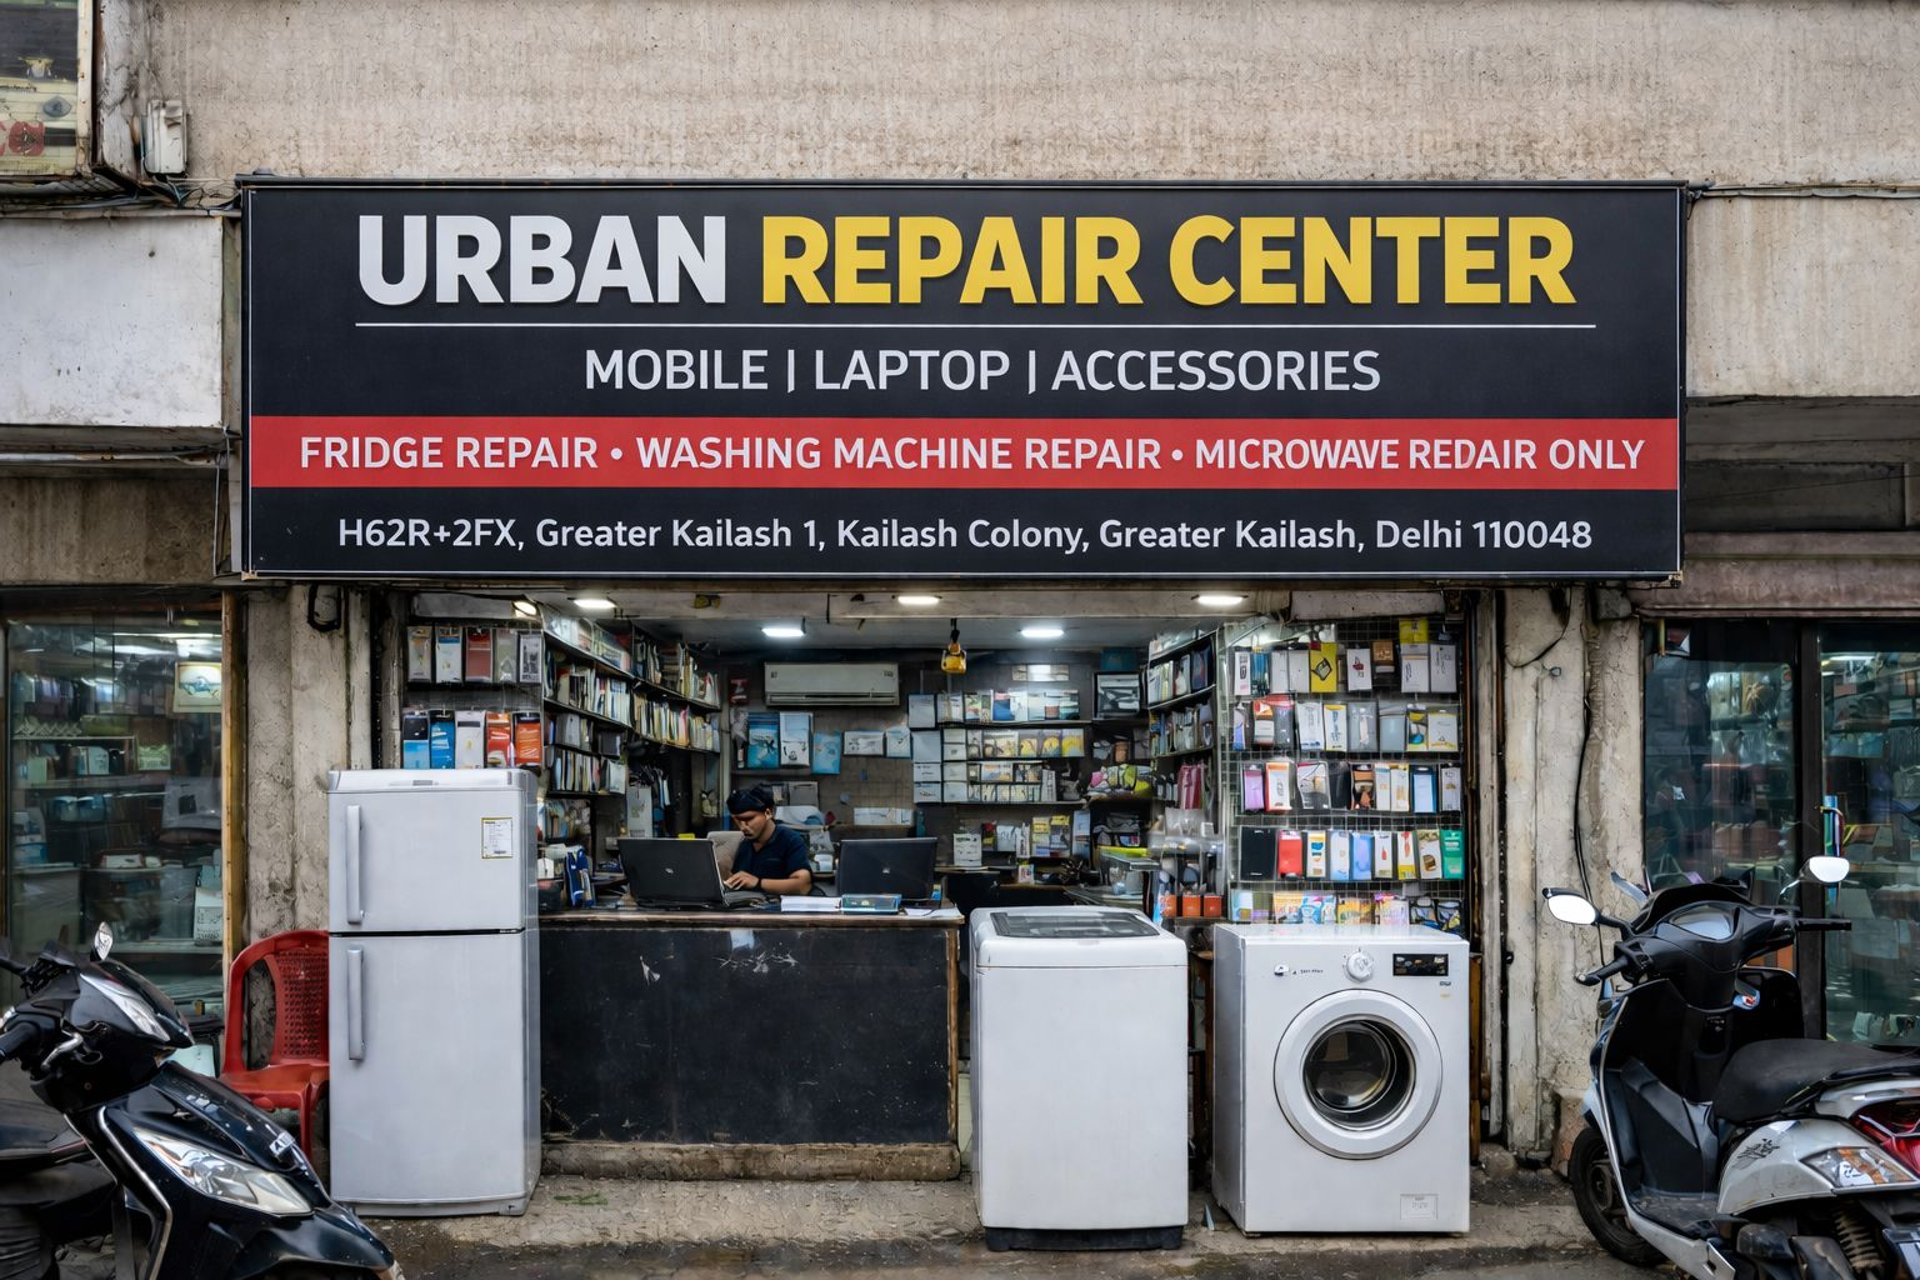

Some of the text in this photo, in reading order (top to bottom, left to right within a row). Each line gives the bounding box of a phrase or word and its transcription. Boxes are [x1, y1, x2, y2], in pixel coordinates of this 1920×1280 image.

[359, 214, 1577, 306] URBAN REPAIR CENTER
[585, 349, 769, 390] MOBILE
[815, 350, 1010, 391] LAPTOP
[1051, 350, 1381, 391] ACCESSORIES
[300, 436, 444, 469] FRIDGE
[456, 436, 599, 469] REPAIR
[635, 436, 821, 470] WASHING
[834, 438, 1013, 470] MACHINE
[1025, 438, 1162, 470] REPAIR
[1195, 438, 1400, 470] MICROWAVE
[1549, 438, 1645, 470] ONLY
[338, 518, 1592, 555] H62R+2FX, Greater Kailash 1, Kailash Colony, Greater Kailash, Delhi 110048
